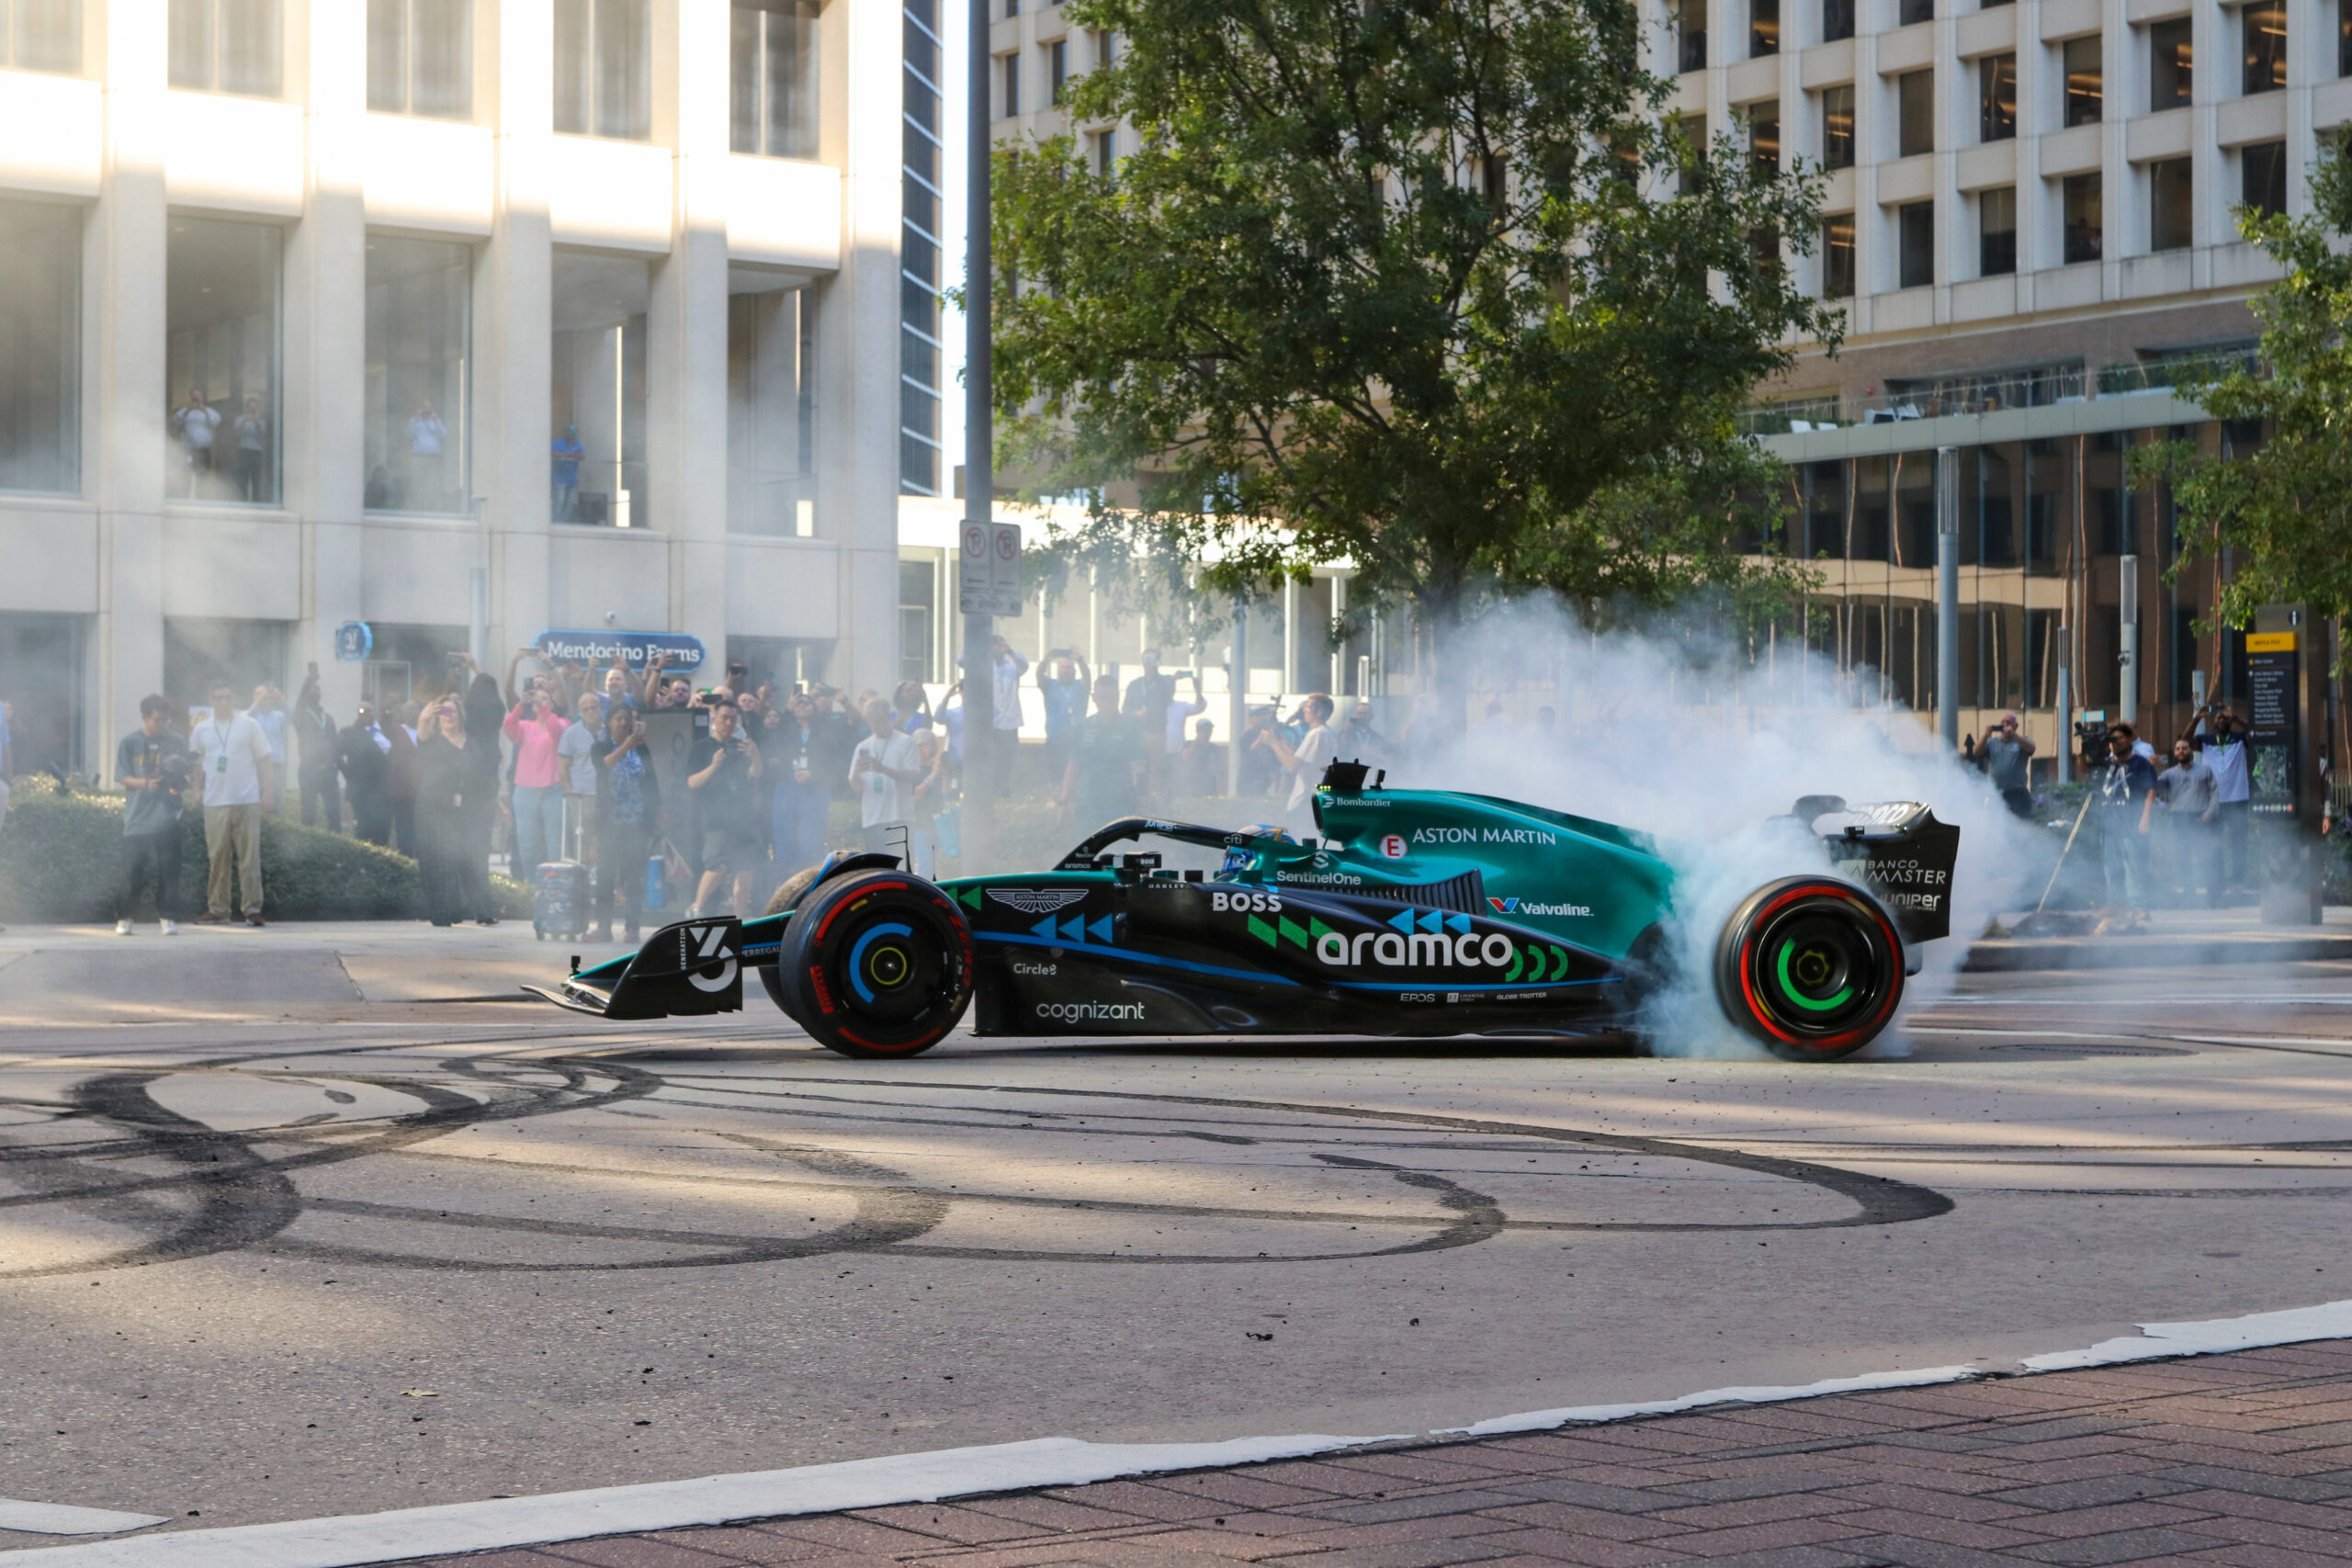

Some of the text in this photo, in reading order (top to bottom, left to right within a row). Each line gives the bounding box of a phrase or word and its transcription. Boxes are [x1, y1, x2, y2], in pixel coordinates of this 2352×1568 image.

[548, 641, 643, 660] Mendocino
[1337, 797, 1392, 807] Bombardier
[1224, 832, 1242, 844] citi
[1412, 828, 1556, 845] ASTON MARTIN
[1386, 838, 1400, 857] E
[1868, 860, 1919, 869] BANCO
[1276, 871, 1362, 886] SentinelOne
[1867, 869, 1947, 885] MASTER
[1212, 892, 1283, 913] BOSS
[1520, 902, 1590, 917] Valvoline
[1316, 932, 1513, 966] aramco
[1400, 993, 1435, 1003] EPOS
[1035, 999, 1146, 1024] cognizant
